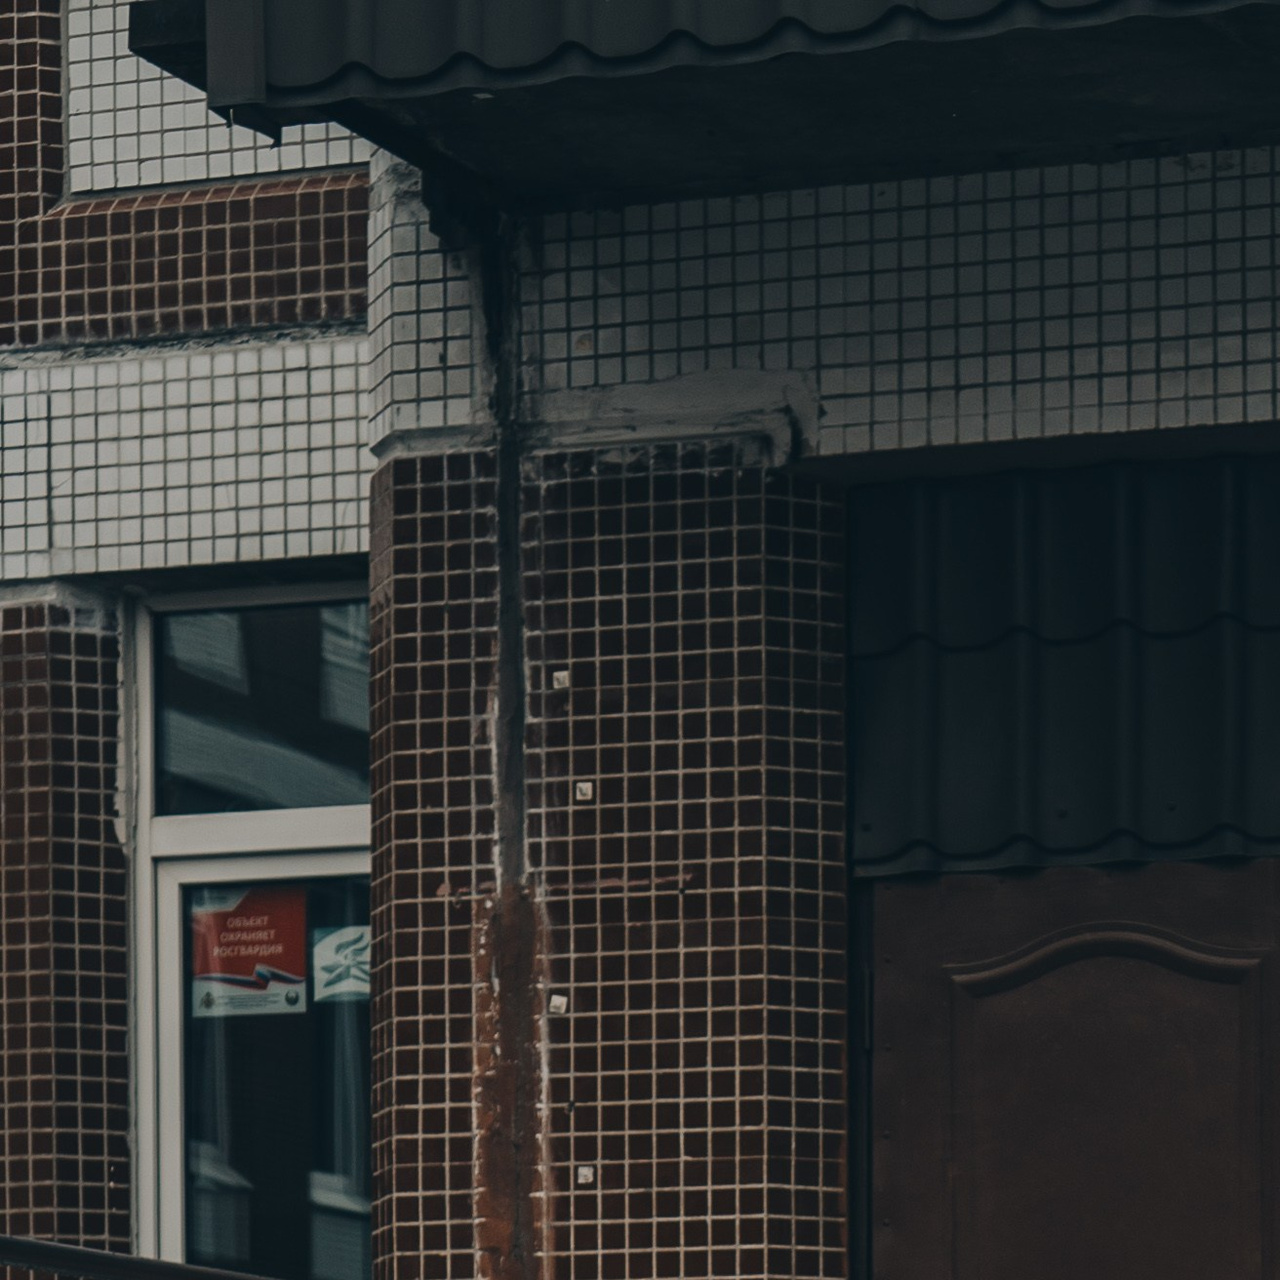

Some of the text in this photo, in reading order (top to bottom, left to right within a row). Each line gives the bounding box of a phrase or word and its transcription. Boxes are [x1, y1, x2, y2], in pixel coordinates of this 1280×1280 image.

[227, 915, 268, 928] ОБЪЕКТ
[219, 929, 275, 943] ОХРАНЯЕТ
[213, 943, 283, 957] РОСГВАРДИЯ
